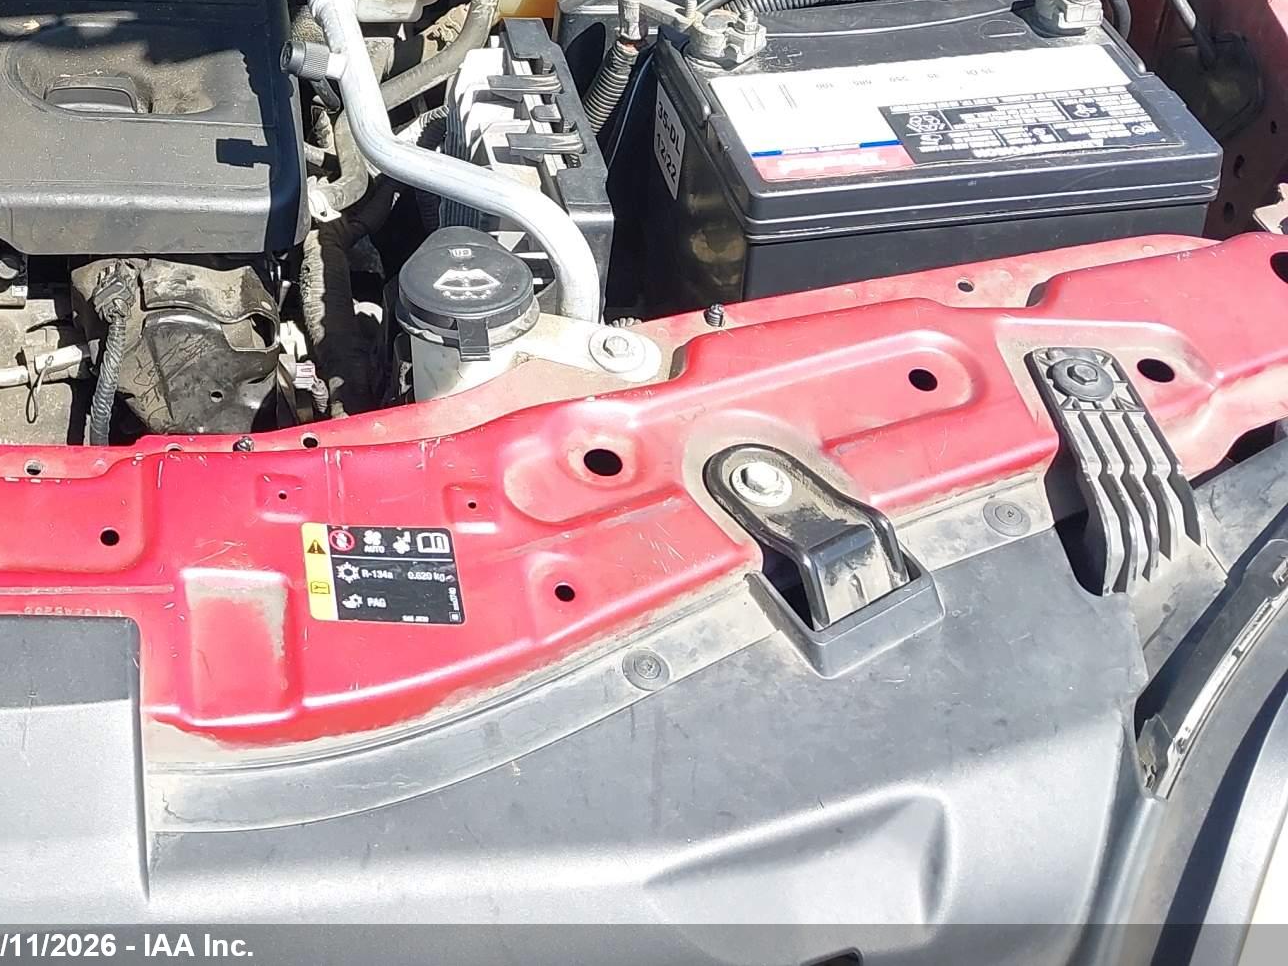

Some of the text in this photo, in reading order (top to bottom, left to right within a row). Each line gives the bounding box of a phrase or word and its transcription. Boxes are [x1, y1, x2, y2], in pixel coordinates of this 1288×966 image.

[658, 100, 681, 157] 35-DL
[656, 132, 677, 185] 1222
[364, 544, 385, 554] AUTO
[361, 568, 394, 580] R-134a
[367, 597, 387, 608] PAG
